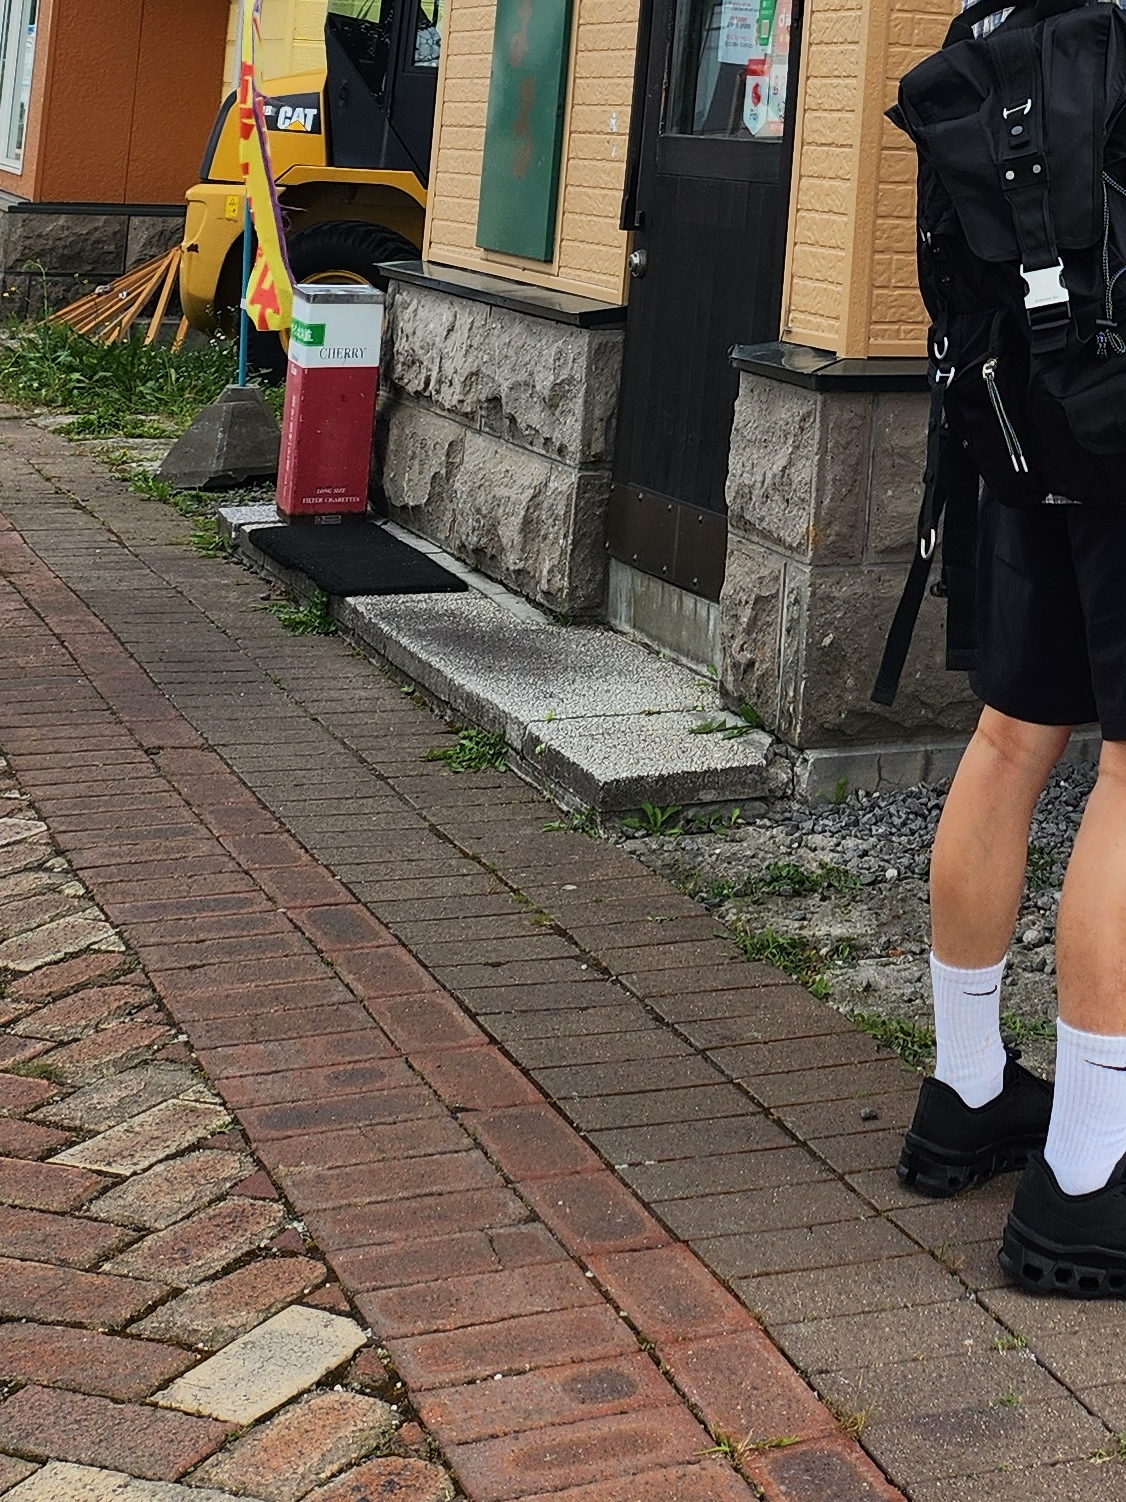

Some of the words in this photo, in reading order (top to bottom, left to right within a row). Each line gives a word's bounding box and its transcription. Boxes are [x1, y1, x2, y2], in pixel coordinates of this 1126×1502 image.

[277, 105, 318, 132] CAT
[319, 347, 367, 362] CHERRY
[333, 486, 346, 494] SIZE
[324, 496, 361, 504] CIGARETTES
